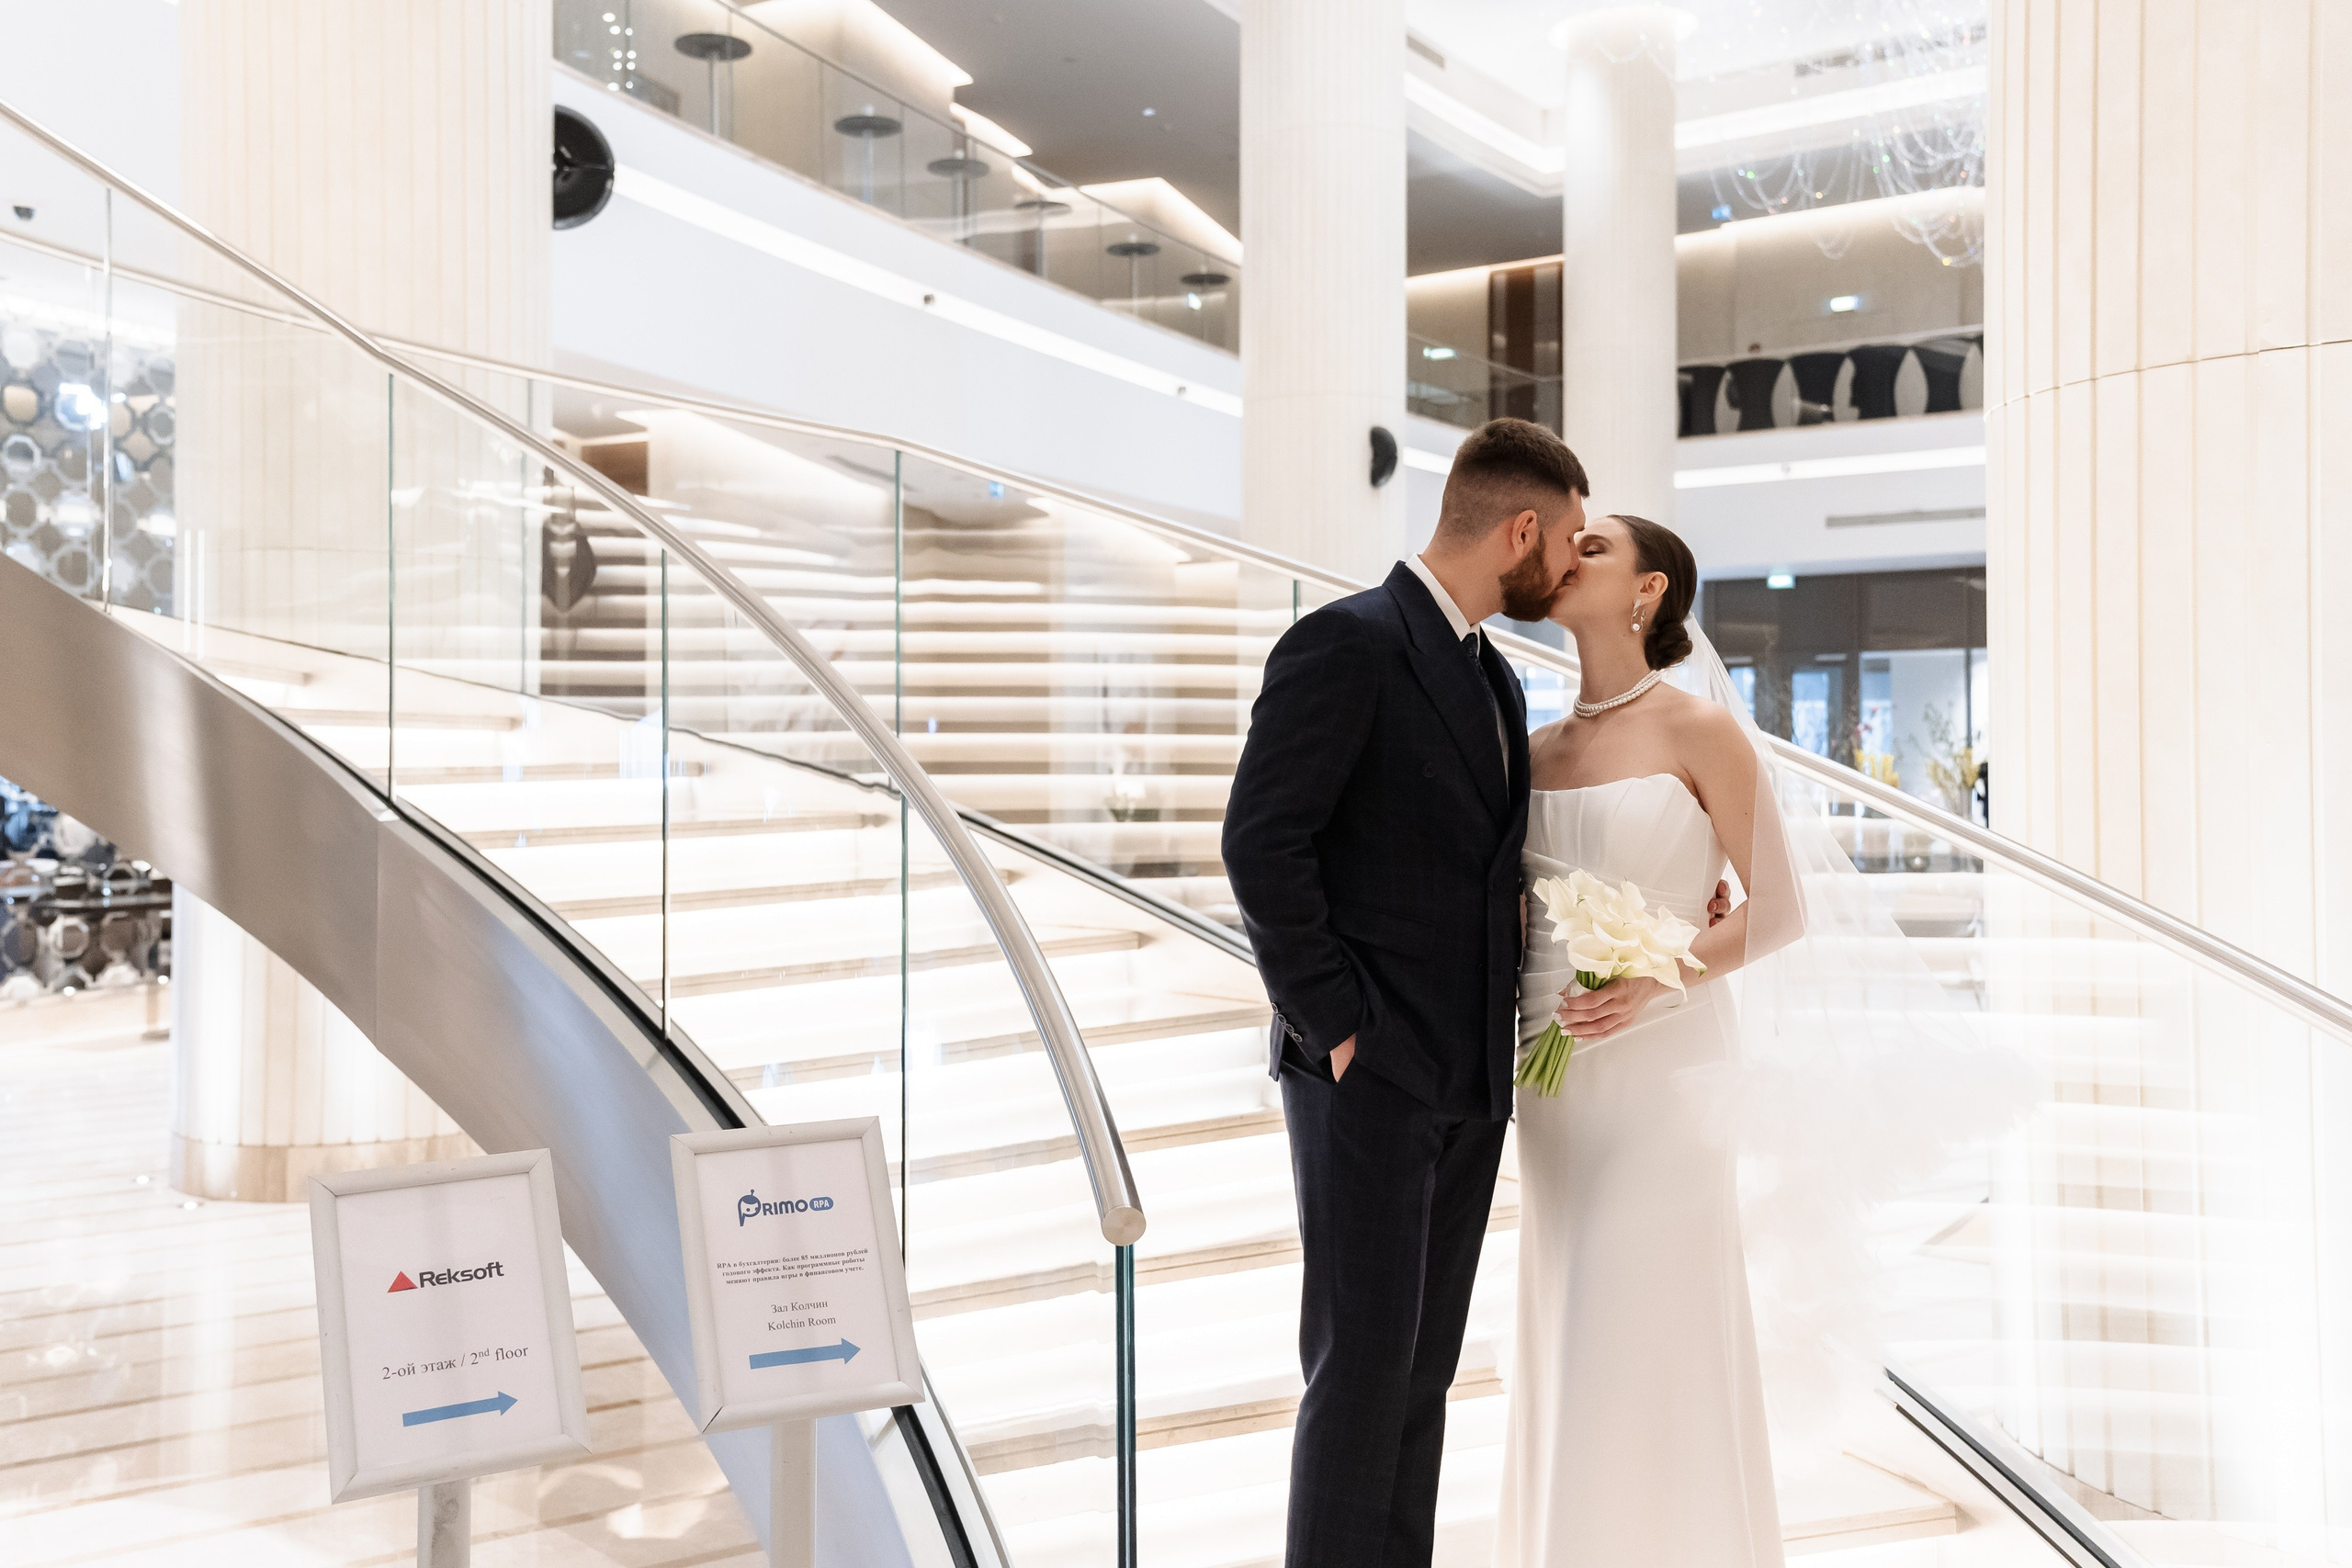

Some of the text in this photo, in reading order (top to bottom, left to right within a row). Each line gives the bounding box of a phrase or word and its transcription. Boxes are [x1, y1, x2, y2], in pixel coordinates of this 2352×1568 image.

[738, 1189, 830, 1226] PRIMO RPA
[739, 1258, 781, 1268] бухгалтерии:
[809, 1251, 845, 1259] миллионов
[846, 1248, 868, 1258] рублей
[753, 1267, 781, 1275] эффекта.
[797, 1260, 841, 1269] программные
[842, 1257, 865, 1266] роботы
[419, 1261, 504, 1288] Reksoft
[752, 1275, 780, 1283] правила
[805, 1268, 844, 1278] финансовом
[771, 1301, 828, 1314] Зал Колчин
[767, 1316, 836, 1331] Kolchin Room
[382, 1362, 416, 1380] 2-ой
[420, 1358, 457, 1373] этаж
[460, 1354, 466, 1368] /
[494, 1347, 529, 1361] floor
